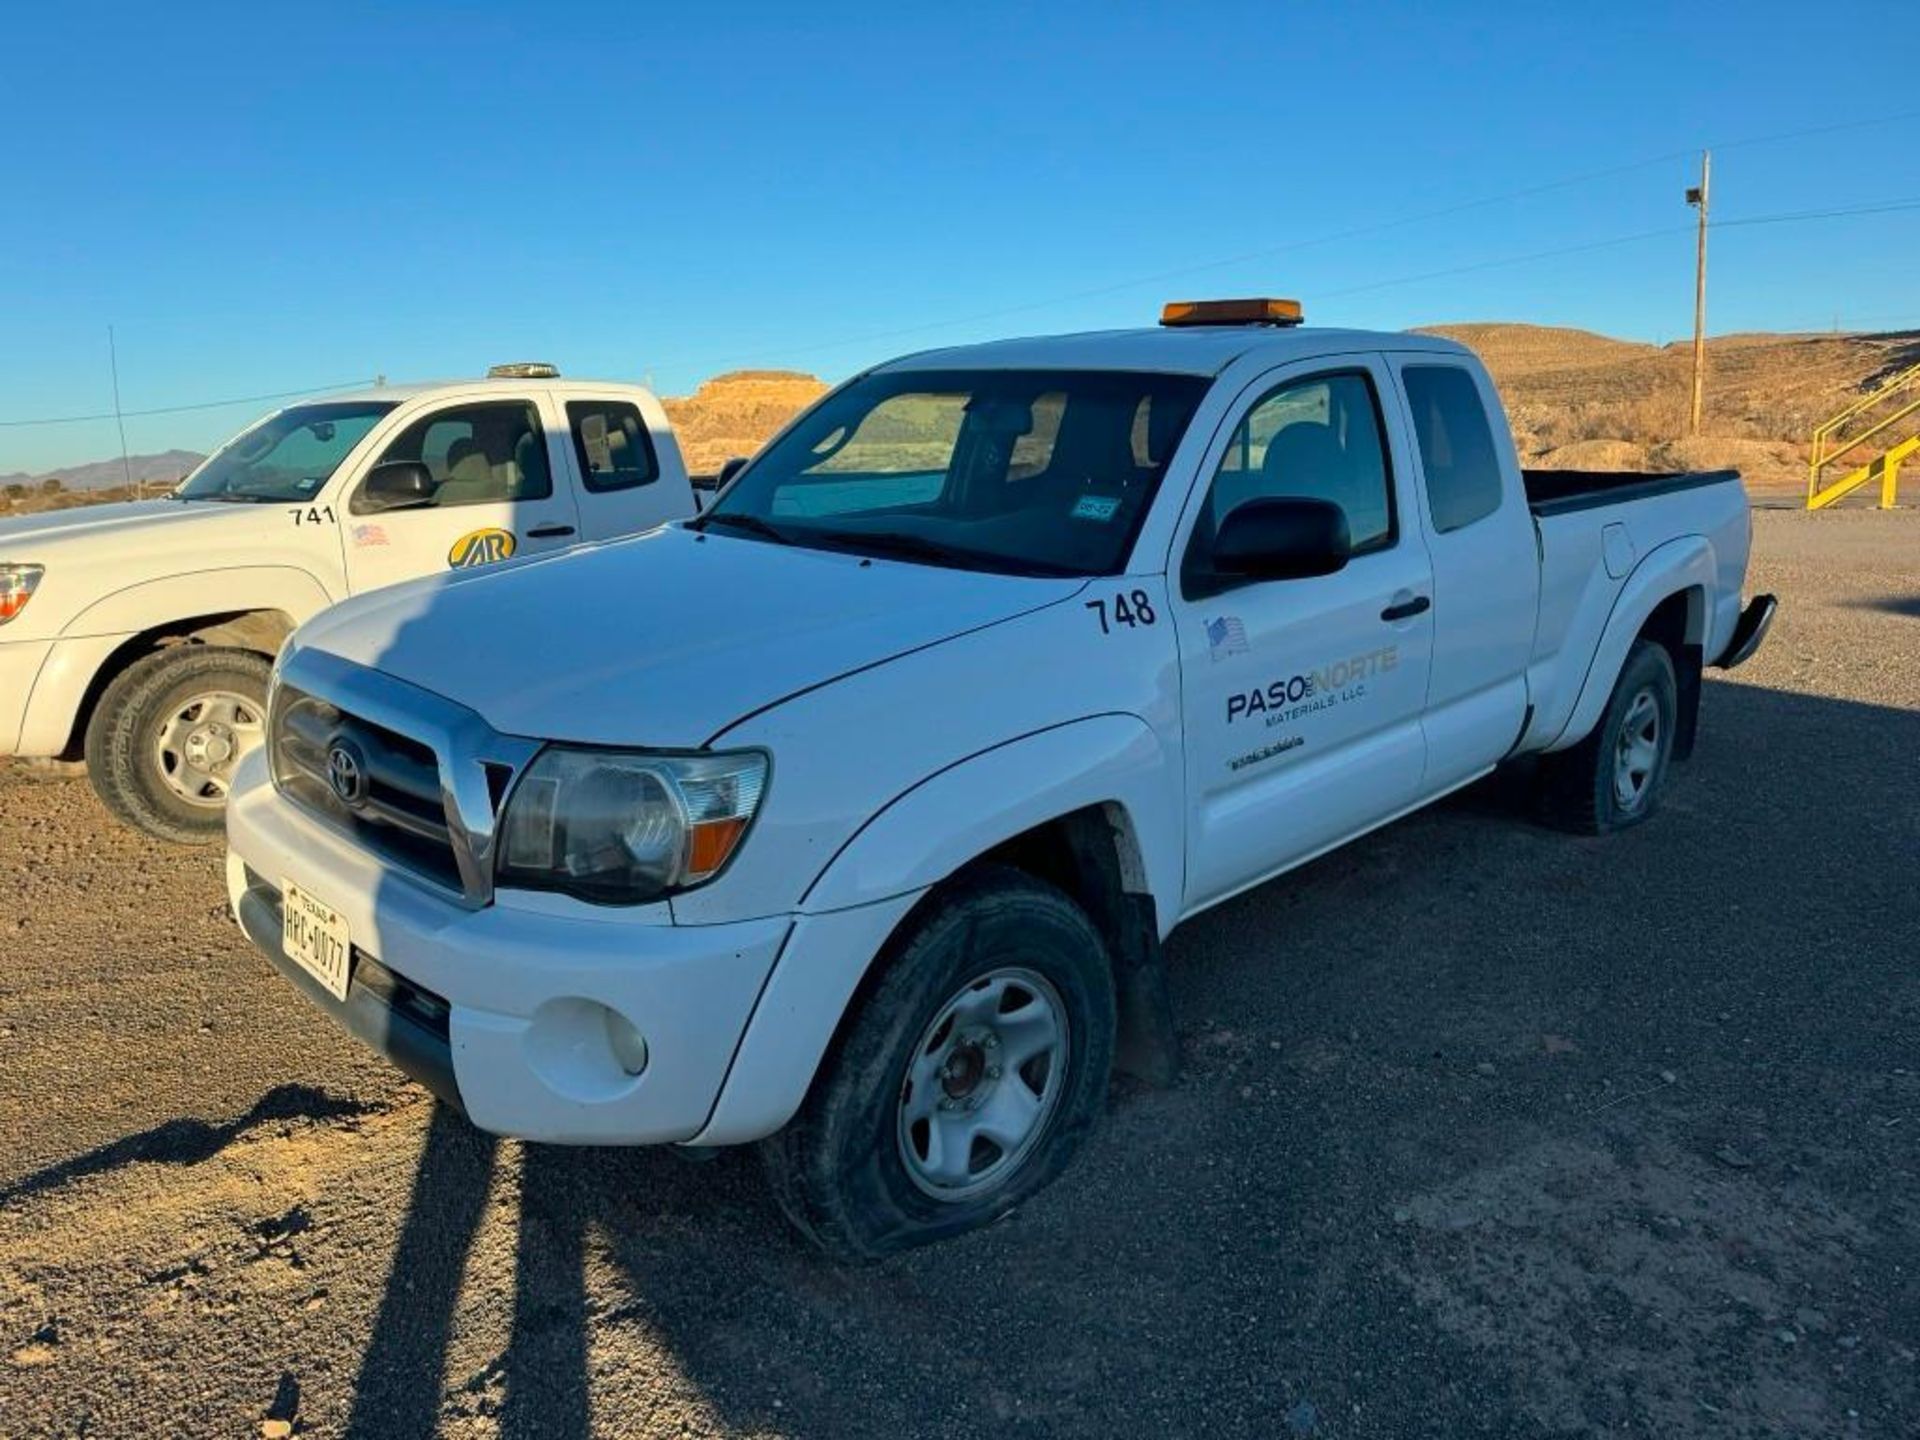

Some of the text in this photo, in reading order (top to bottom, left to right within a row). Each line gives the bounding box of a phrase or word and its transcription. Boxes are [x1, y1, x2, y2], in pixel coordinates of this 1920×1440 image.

[288, 505, 335, 526] 741
[1085, 590, 1155, 635] 748
[1227, 676, 1306, 724] PASO
[1310, 646, 1397, 692] NORTE
